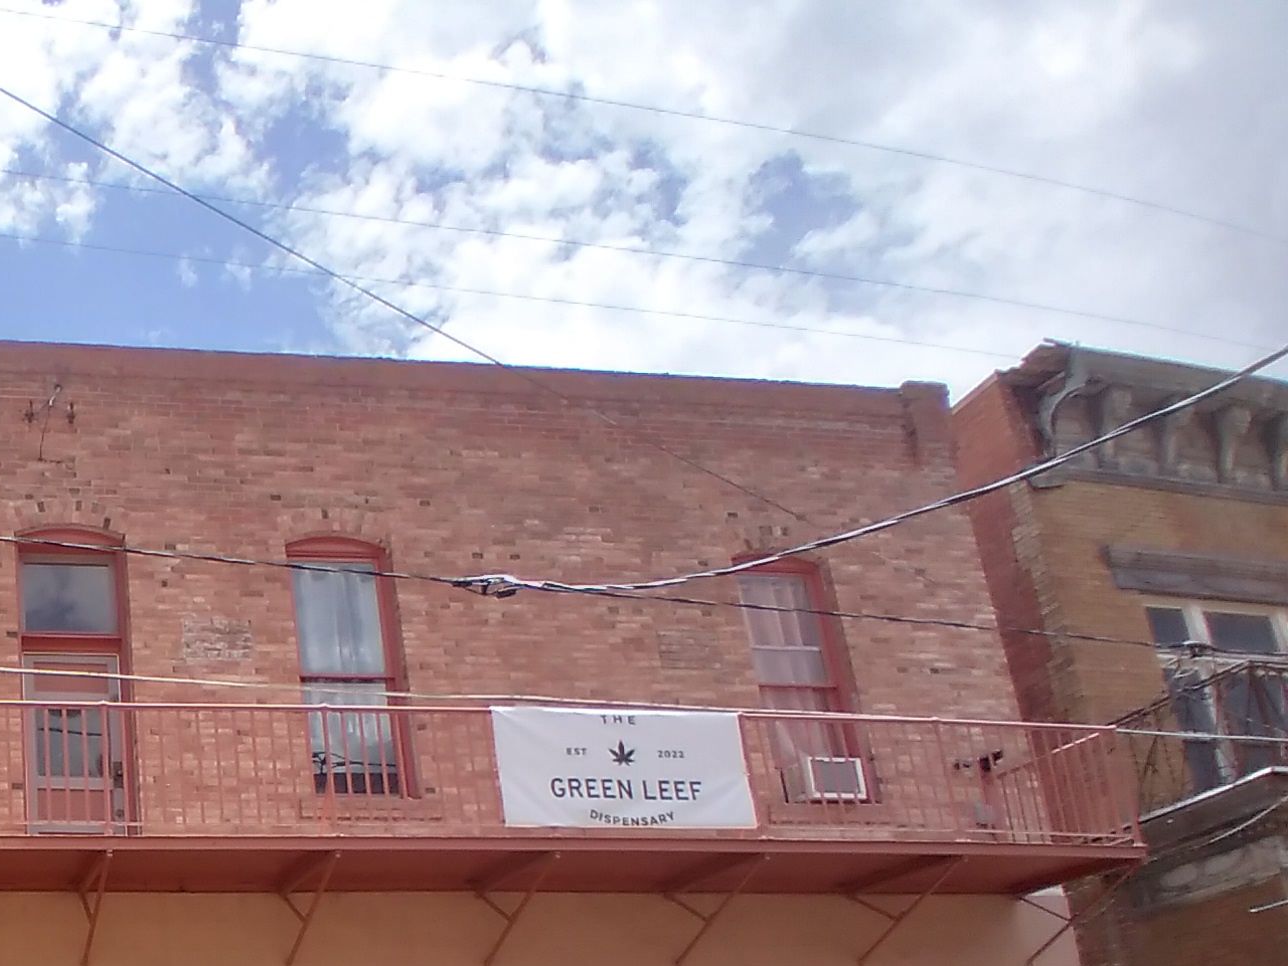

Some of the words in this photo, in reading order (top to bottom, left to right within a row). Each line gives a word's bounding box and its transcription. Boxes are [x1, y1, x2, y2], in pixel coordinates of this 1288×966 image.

[600, 714, 637, 726] THE
[565, 747, 588, 756] EST
[656, 749, 686, 759] 2022
[549, 777, 634, 800] GREEN
[642, 780, 702, 801] LEEF
[589, 809, 675, 827] DISPENSARY
